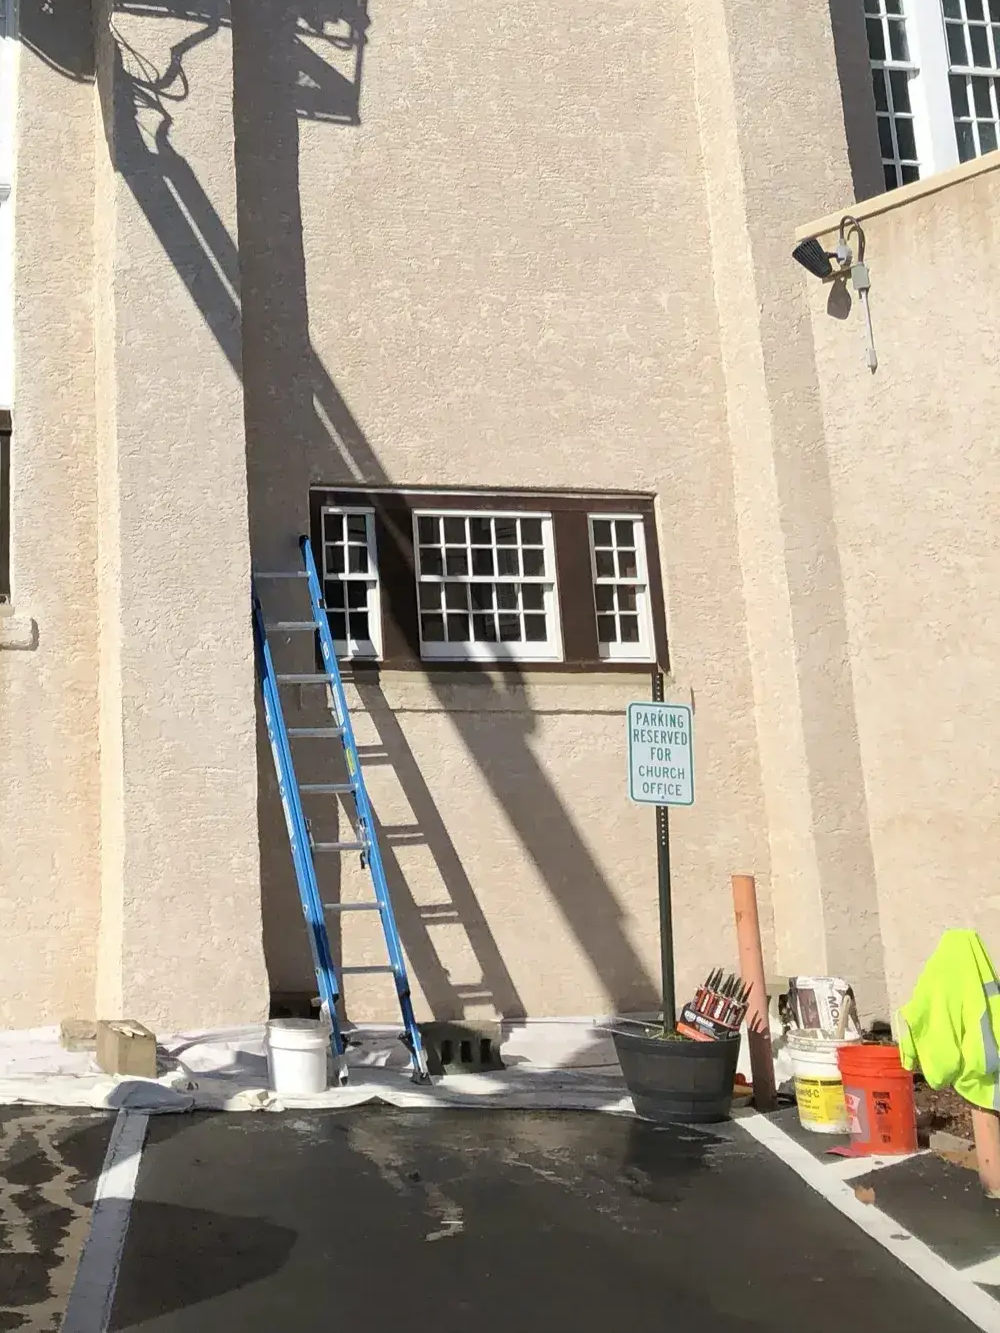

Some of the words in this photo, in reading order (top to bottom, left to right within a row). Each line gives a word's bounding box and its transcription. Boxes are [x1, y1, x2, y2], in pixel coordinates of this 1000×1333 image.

[636, 712, 684, 728] PARKING
[633, 729, 687, 745] RESERVED
[650, 747, 671, 761] FOR
[638, 765, 685, 779] CHURCH
[642, 781, 682, 796] OFFICE
